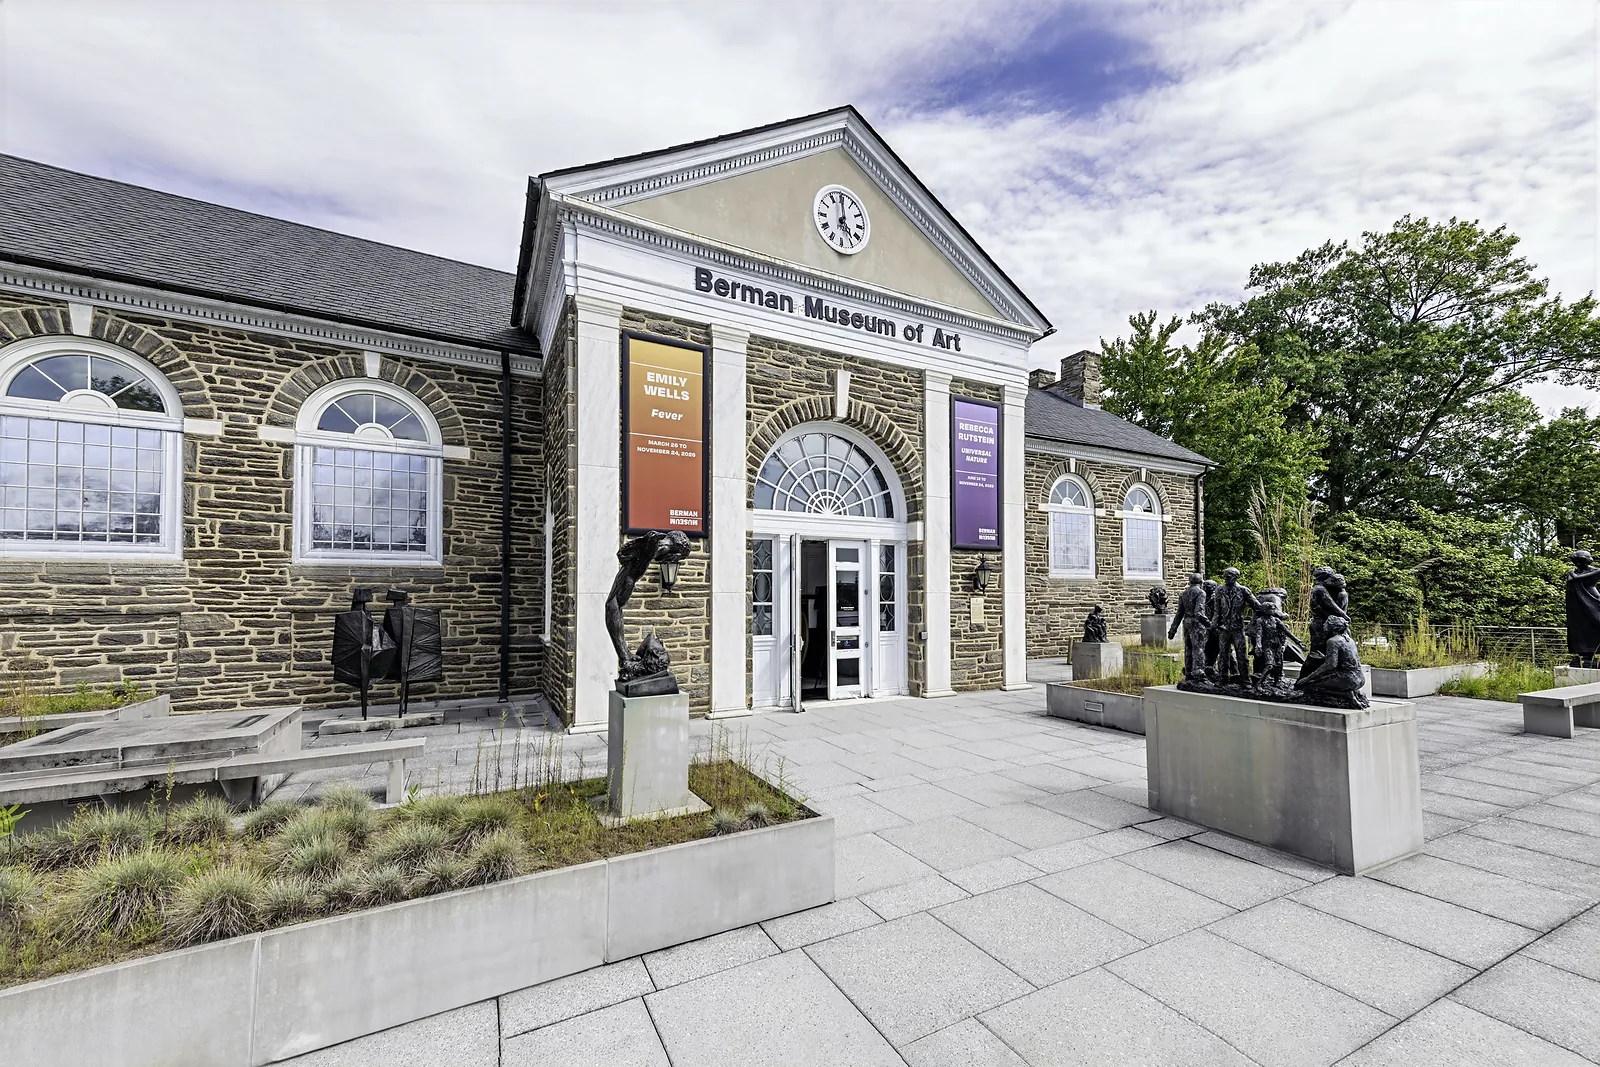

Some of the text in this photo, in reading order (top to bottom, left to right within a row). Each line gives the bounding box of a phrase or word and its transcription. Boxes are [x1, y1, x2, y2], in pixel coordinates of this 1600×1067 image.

[694, 266, 961, 352] Berman Museum of Art
[646, 371, 688, 388] EMILY
[643, 384, 690, 401] WELLS
[651, 408, 683, 421] Fever
[959, 422, 994, 435] REBECCA
[647, 439, 669, 447] MARCH
[958, 432, 995, 445] RUTSTEIN
[636, 446, 670, 455] NOVEMBER
[961, 447, 992, 457] UNIVERSAL
[965, 455, 988, 464] NATURE
[669, 509, 698, 517] BERMAN
[669, 518, 698, 526] MUSEUM
